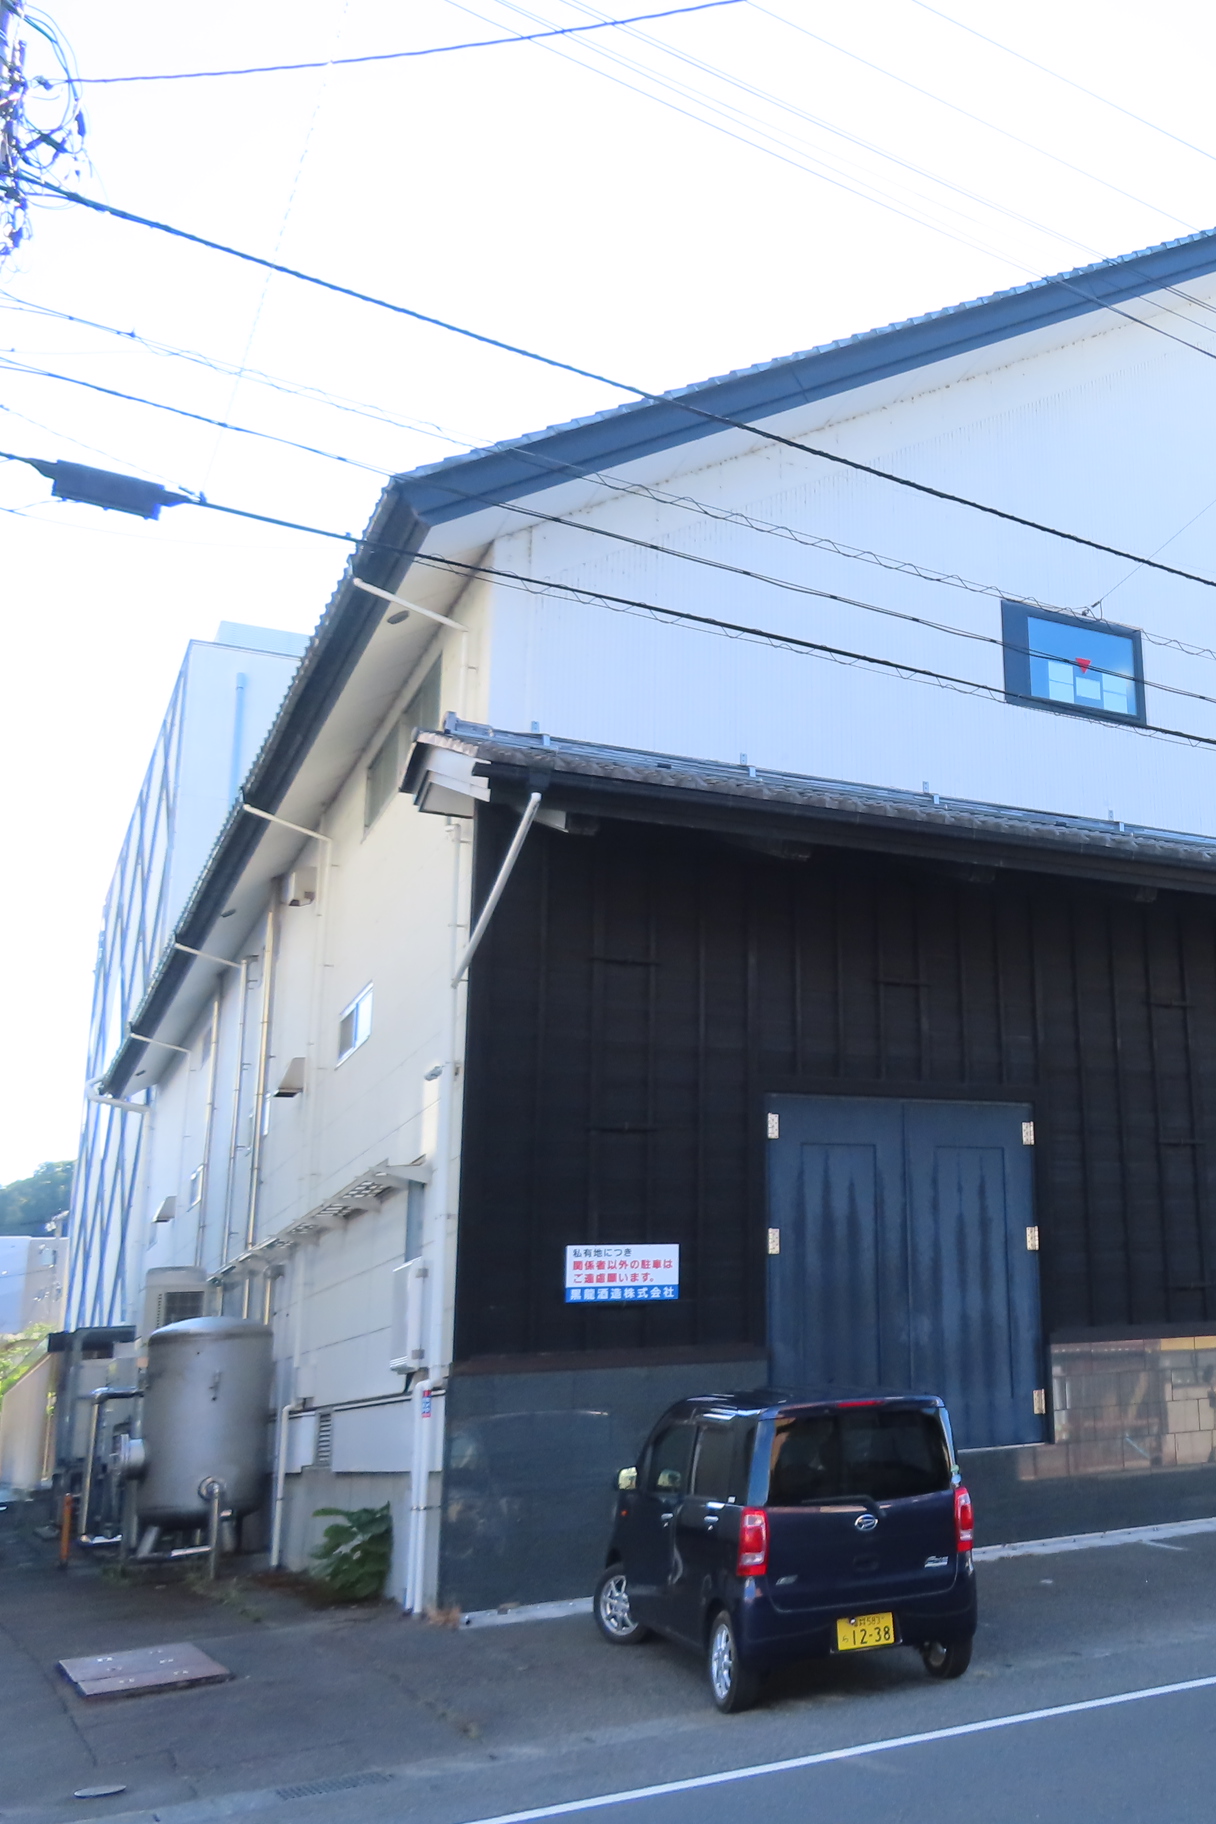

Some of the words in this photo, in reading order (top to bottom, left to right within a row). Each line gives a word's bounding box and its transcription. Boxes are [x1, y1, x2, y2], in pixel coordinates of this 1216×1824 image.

[573, 1248, 632, 1258] 私有地につき
[572, 1259, 673, 1271] 関係者以外の駐車は
[573, 1272, 655, 1284] ご遠慮願います。
[570, 1286, 675, 1301] 黒龍酒造株式会社
[852, 1625, 891, 1646] 12-38
